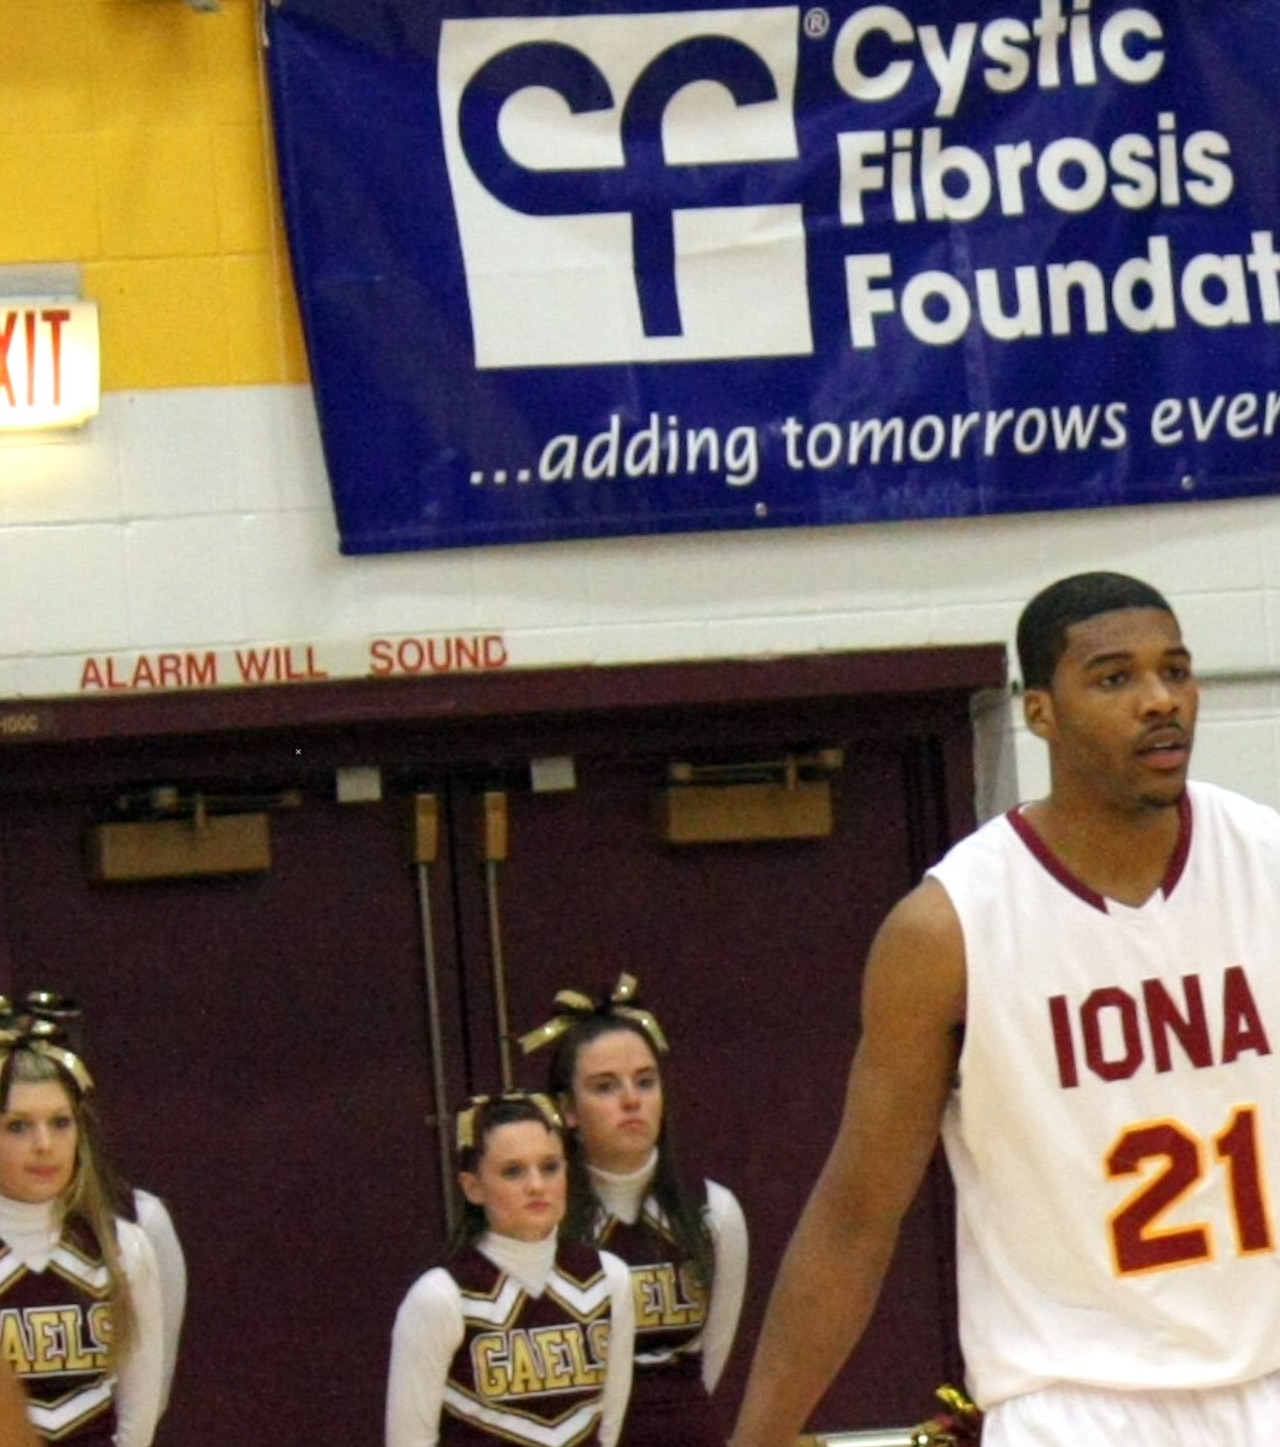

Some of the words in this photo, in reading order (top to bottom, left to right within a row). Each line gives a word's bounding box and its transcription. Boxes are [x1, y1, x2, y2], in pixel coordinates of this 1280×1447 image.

[832, 0, 1165, 117] Cystic
[837, 112, 1234, 226] Fibrosis
[781, 402, 1128, 470] tomorrows
[80, 651, 217, 690] ALARM
[235, 645, 329, 682] WILL
[370, 635, 508, 676] SOUND
[1047, 964, 1273, 1090] IONA
[1104, 1103, 1277, 1279] 21
